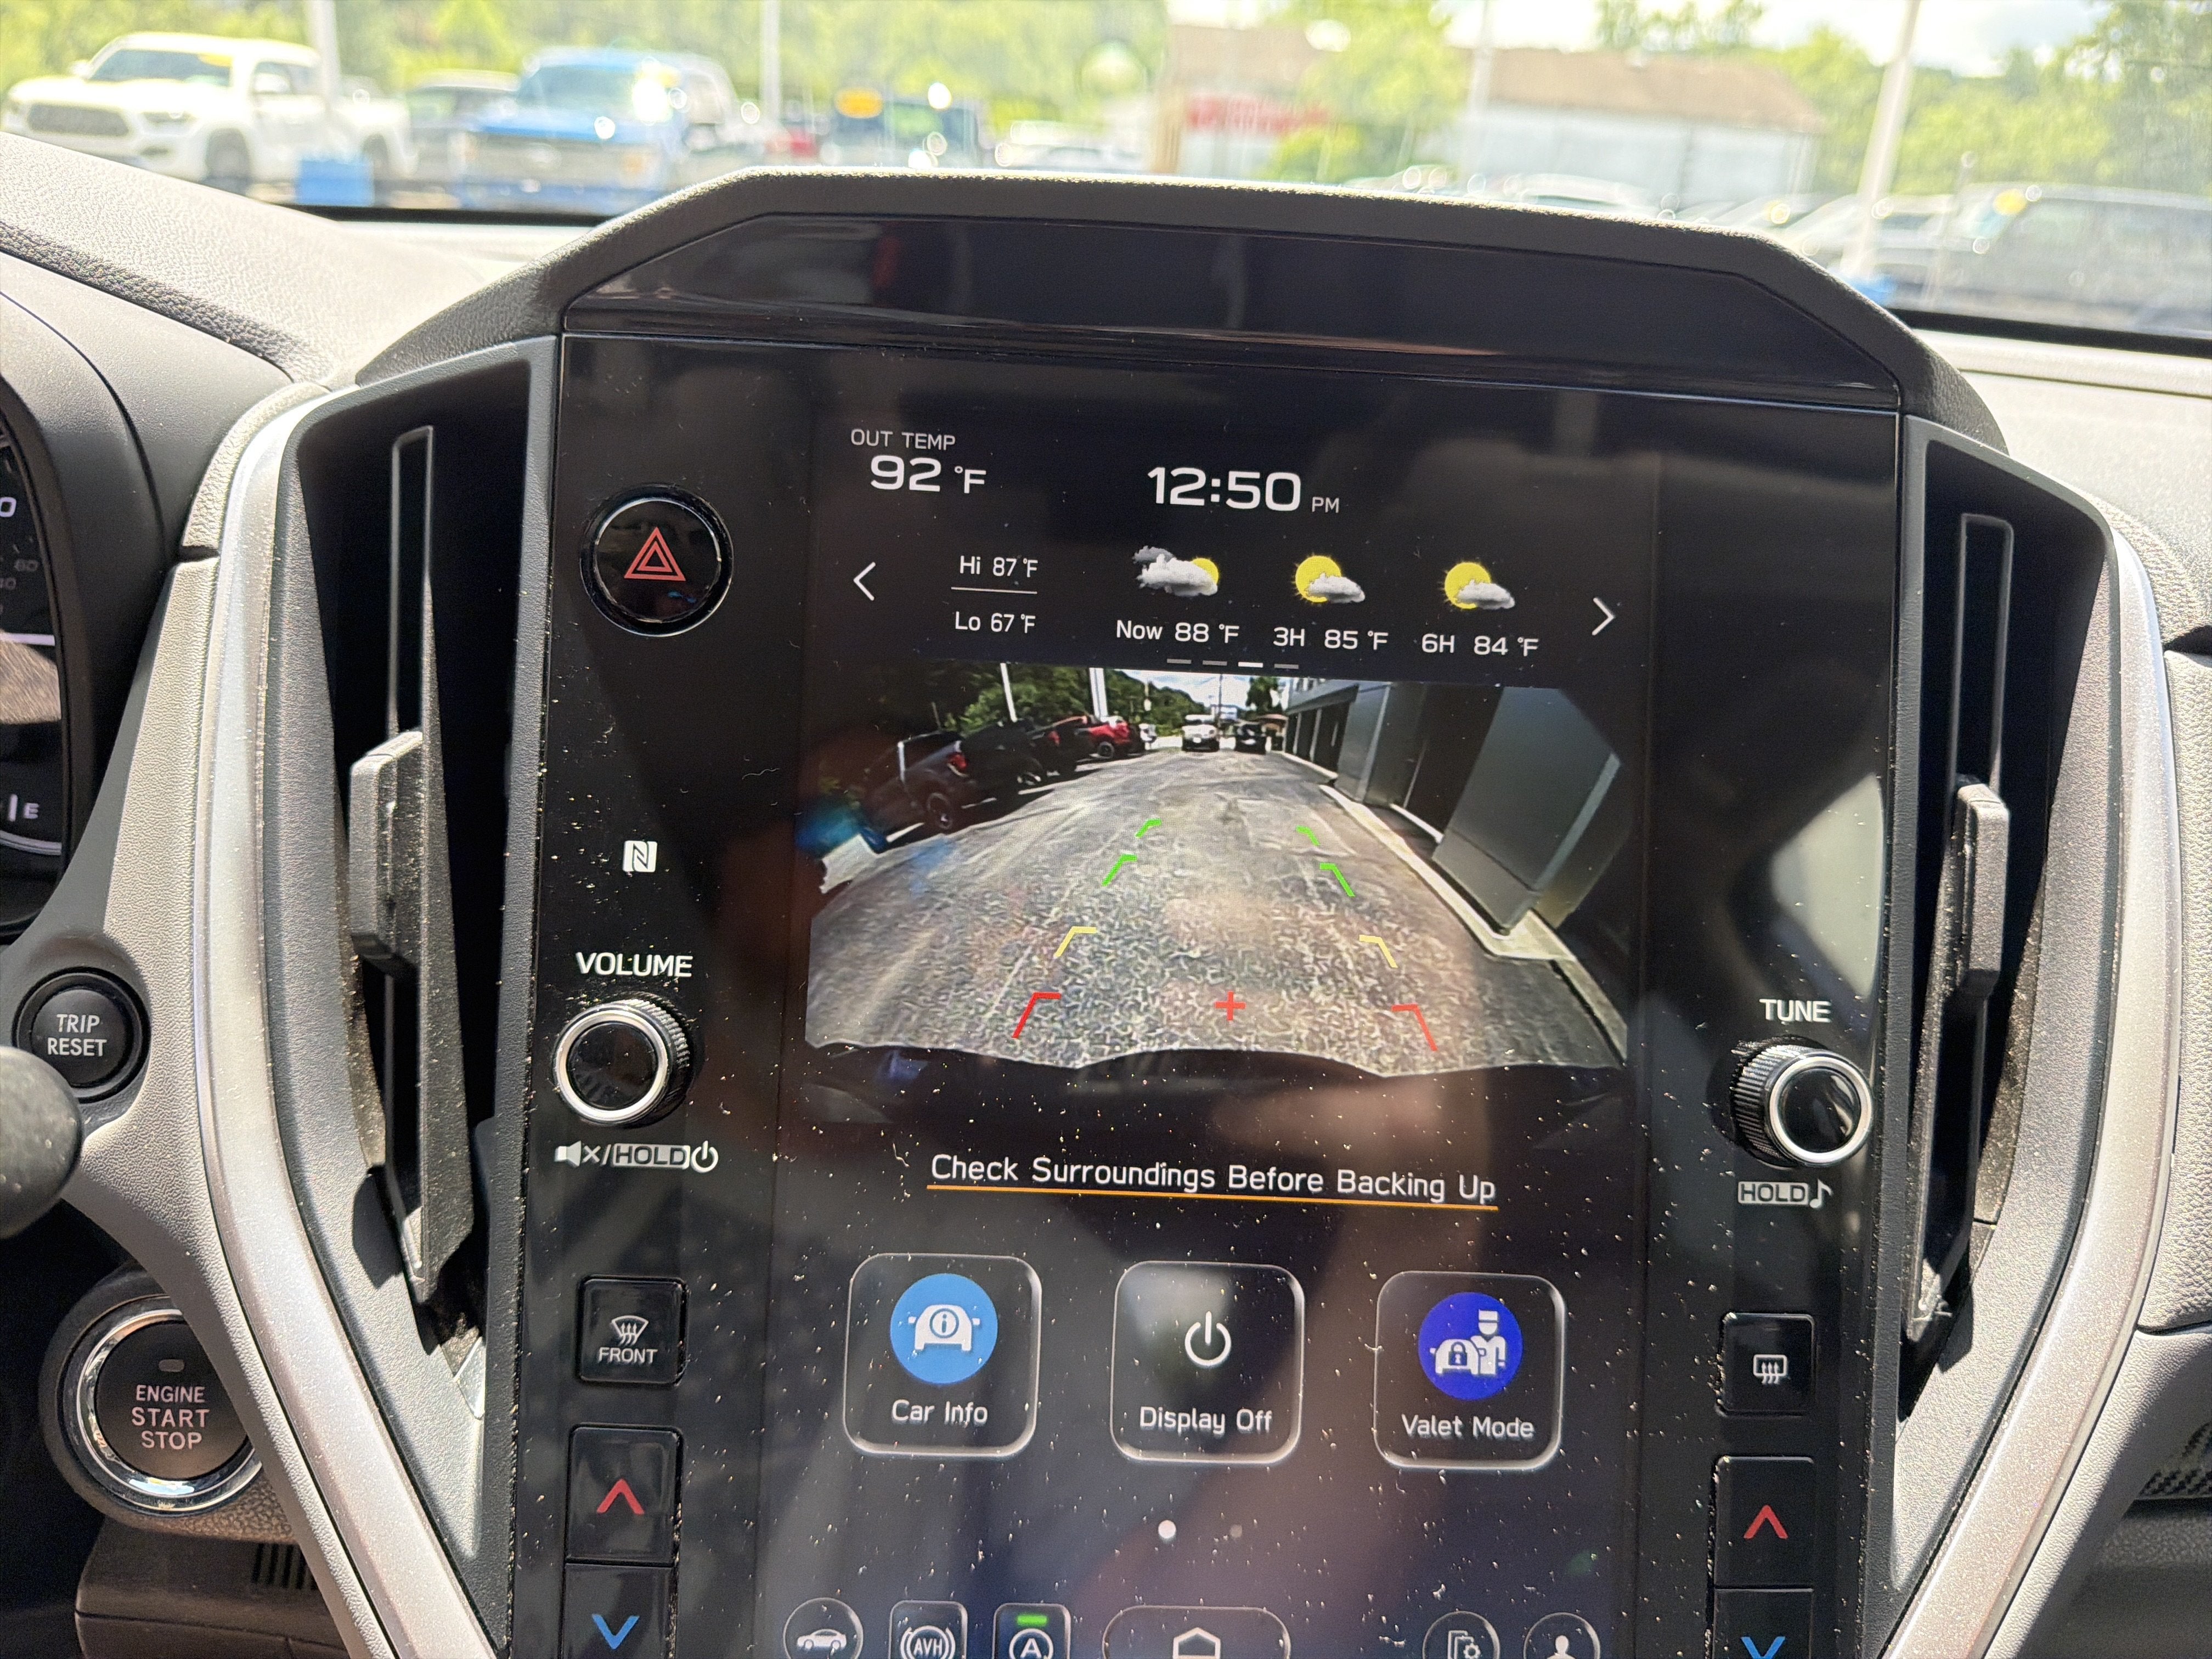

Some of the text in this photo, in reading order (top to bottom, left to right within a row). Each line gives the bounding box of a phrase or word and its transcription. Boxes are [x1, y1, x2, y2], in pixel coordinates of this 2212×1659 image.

[851, 428, 956, 451] OUT TEMP
[870, 454, 942, 492] 92
[1147, 466, 1340, 514] 12:50 PM
[959, 555, 981, 576] Hi
[992, 557, 1018, 577] 87
[955, 611, 981, 633] Lo
[990, 613, 1015, 633] 67
[1116, 619, 1163, 641] Now
[1175, 623, 1209, 643] 88
[1273, 627, 1305, 647] 3H
[1324, 629, 1358, 650] 85
[1421, 633, 1455, 654] 6H
[1474, 636, 1508, 656] 84
[23, 804, 39, 820] E
[575, 952, 693, 978] VOLUME
[1759, 998, 1832, 1023] TUNE
[57, 1014, 100, 1033] TRIP
[47, 1037, 107, 1057] RESET
[614, 1146, 687, 1166] HOLD
[931, 1154, 1496, 1204] Check Surroundings Before Backing Up
[1740, 1183, 1806, 1203] HOLD
[598, 1347, 658, 1363] FRONT
[136, 1385, 205, 1403] ENGINE
[132, 1407, 210, 1427] START
[891, 1399, 989, 1426] Car Info
[1138, 1406, 1273, 1434] Display Off
[1401, 1414, 1535, 1441] Valet Mode
[141, 1430, 202, 1449] STOP
[913, 1638, 944, 1655] AVH
